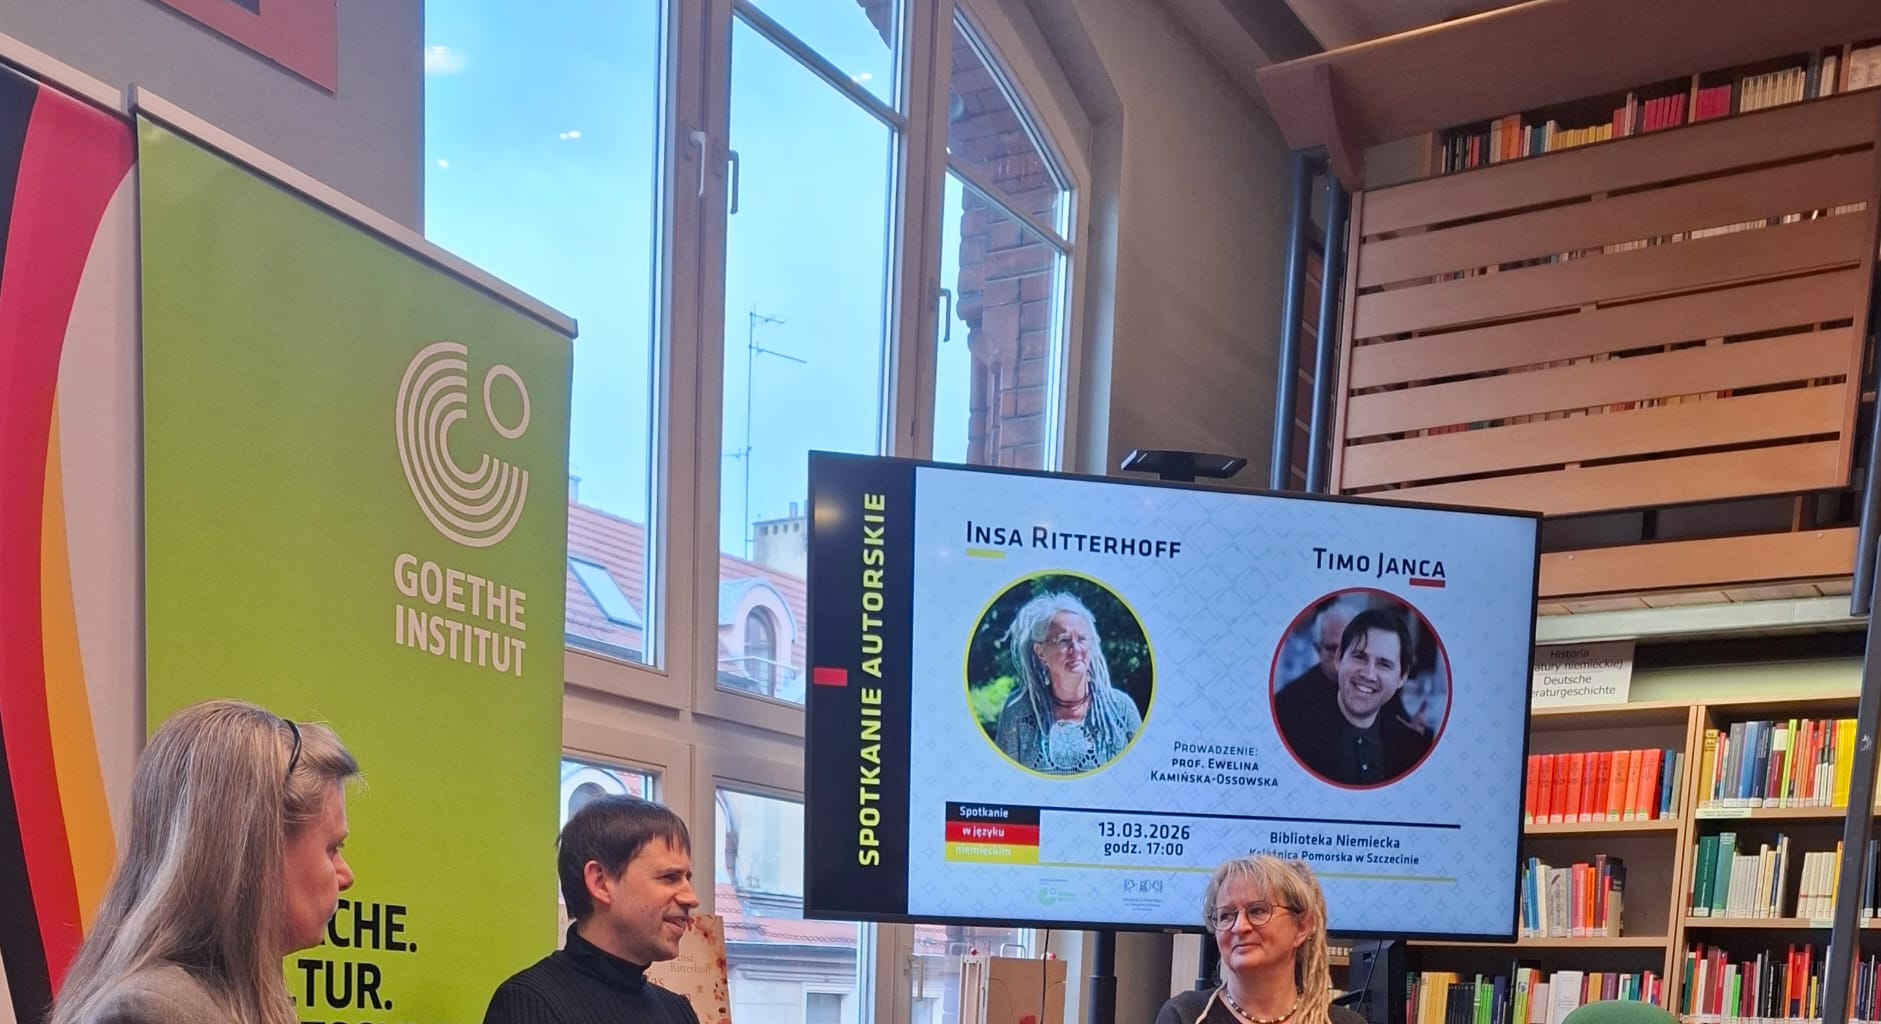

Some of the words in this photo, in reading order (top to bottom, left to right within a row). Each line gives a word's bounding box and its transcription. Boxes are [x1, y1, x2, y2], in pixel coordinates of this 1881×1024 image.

[967, 521, 1023, 547] INSA
[1032, 526, 1181, 559] RITTERHOFF
[1313, 547, 1370, 572] TIMO
[1377, 552, 1446, 578] JANCA
[394, 553, 526, 630] GOETHE
[862, 493, 885, 678] AUTORSKIE
[395, 604, 526, 677] INSTITUT
[1550, 649, 1590, 659] Historia
[1564, 658, 1623, 670] niemieckiej
[1543, 674, 1592, 685] Deutsche
[1174, 741, 1258, 756] PROWADZENIE:
[1172, 758, 1204, 768] PROF.
[1208, 758, 1259, 771] EWELINA
[859, 688, 882, 866] SPOTKANIE
[1151, 770, 1278, 787] KAMIŃSKA-OSSOWSKA
[960, 806, 1008, 818] Spotkanie
[962, 827, 971, 836] w
[973, 825, 1005, 838] języku
[1098, 821, 1190, 840] 13.03.2026
[1104, 841, 1141, 856] godz.
[1147, 842, 1183, 856] 17:00
[1270, 832, 1332, 846] Biblioteka
[1336, 834, 1400, 849] Niemiecka
[1302, 850, 1352, 862] Pomorska
[1355, 855, 1364, 863] w
[1367, 853, 1419, 865] Szczecinie
[320, 899, 417, 952] CHE.
[288, 959, 393, 1011] TUR.
